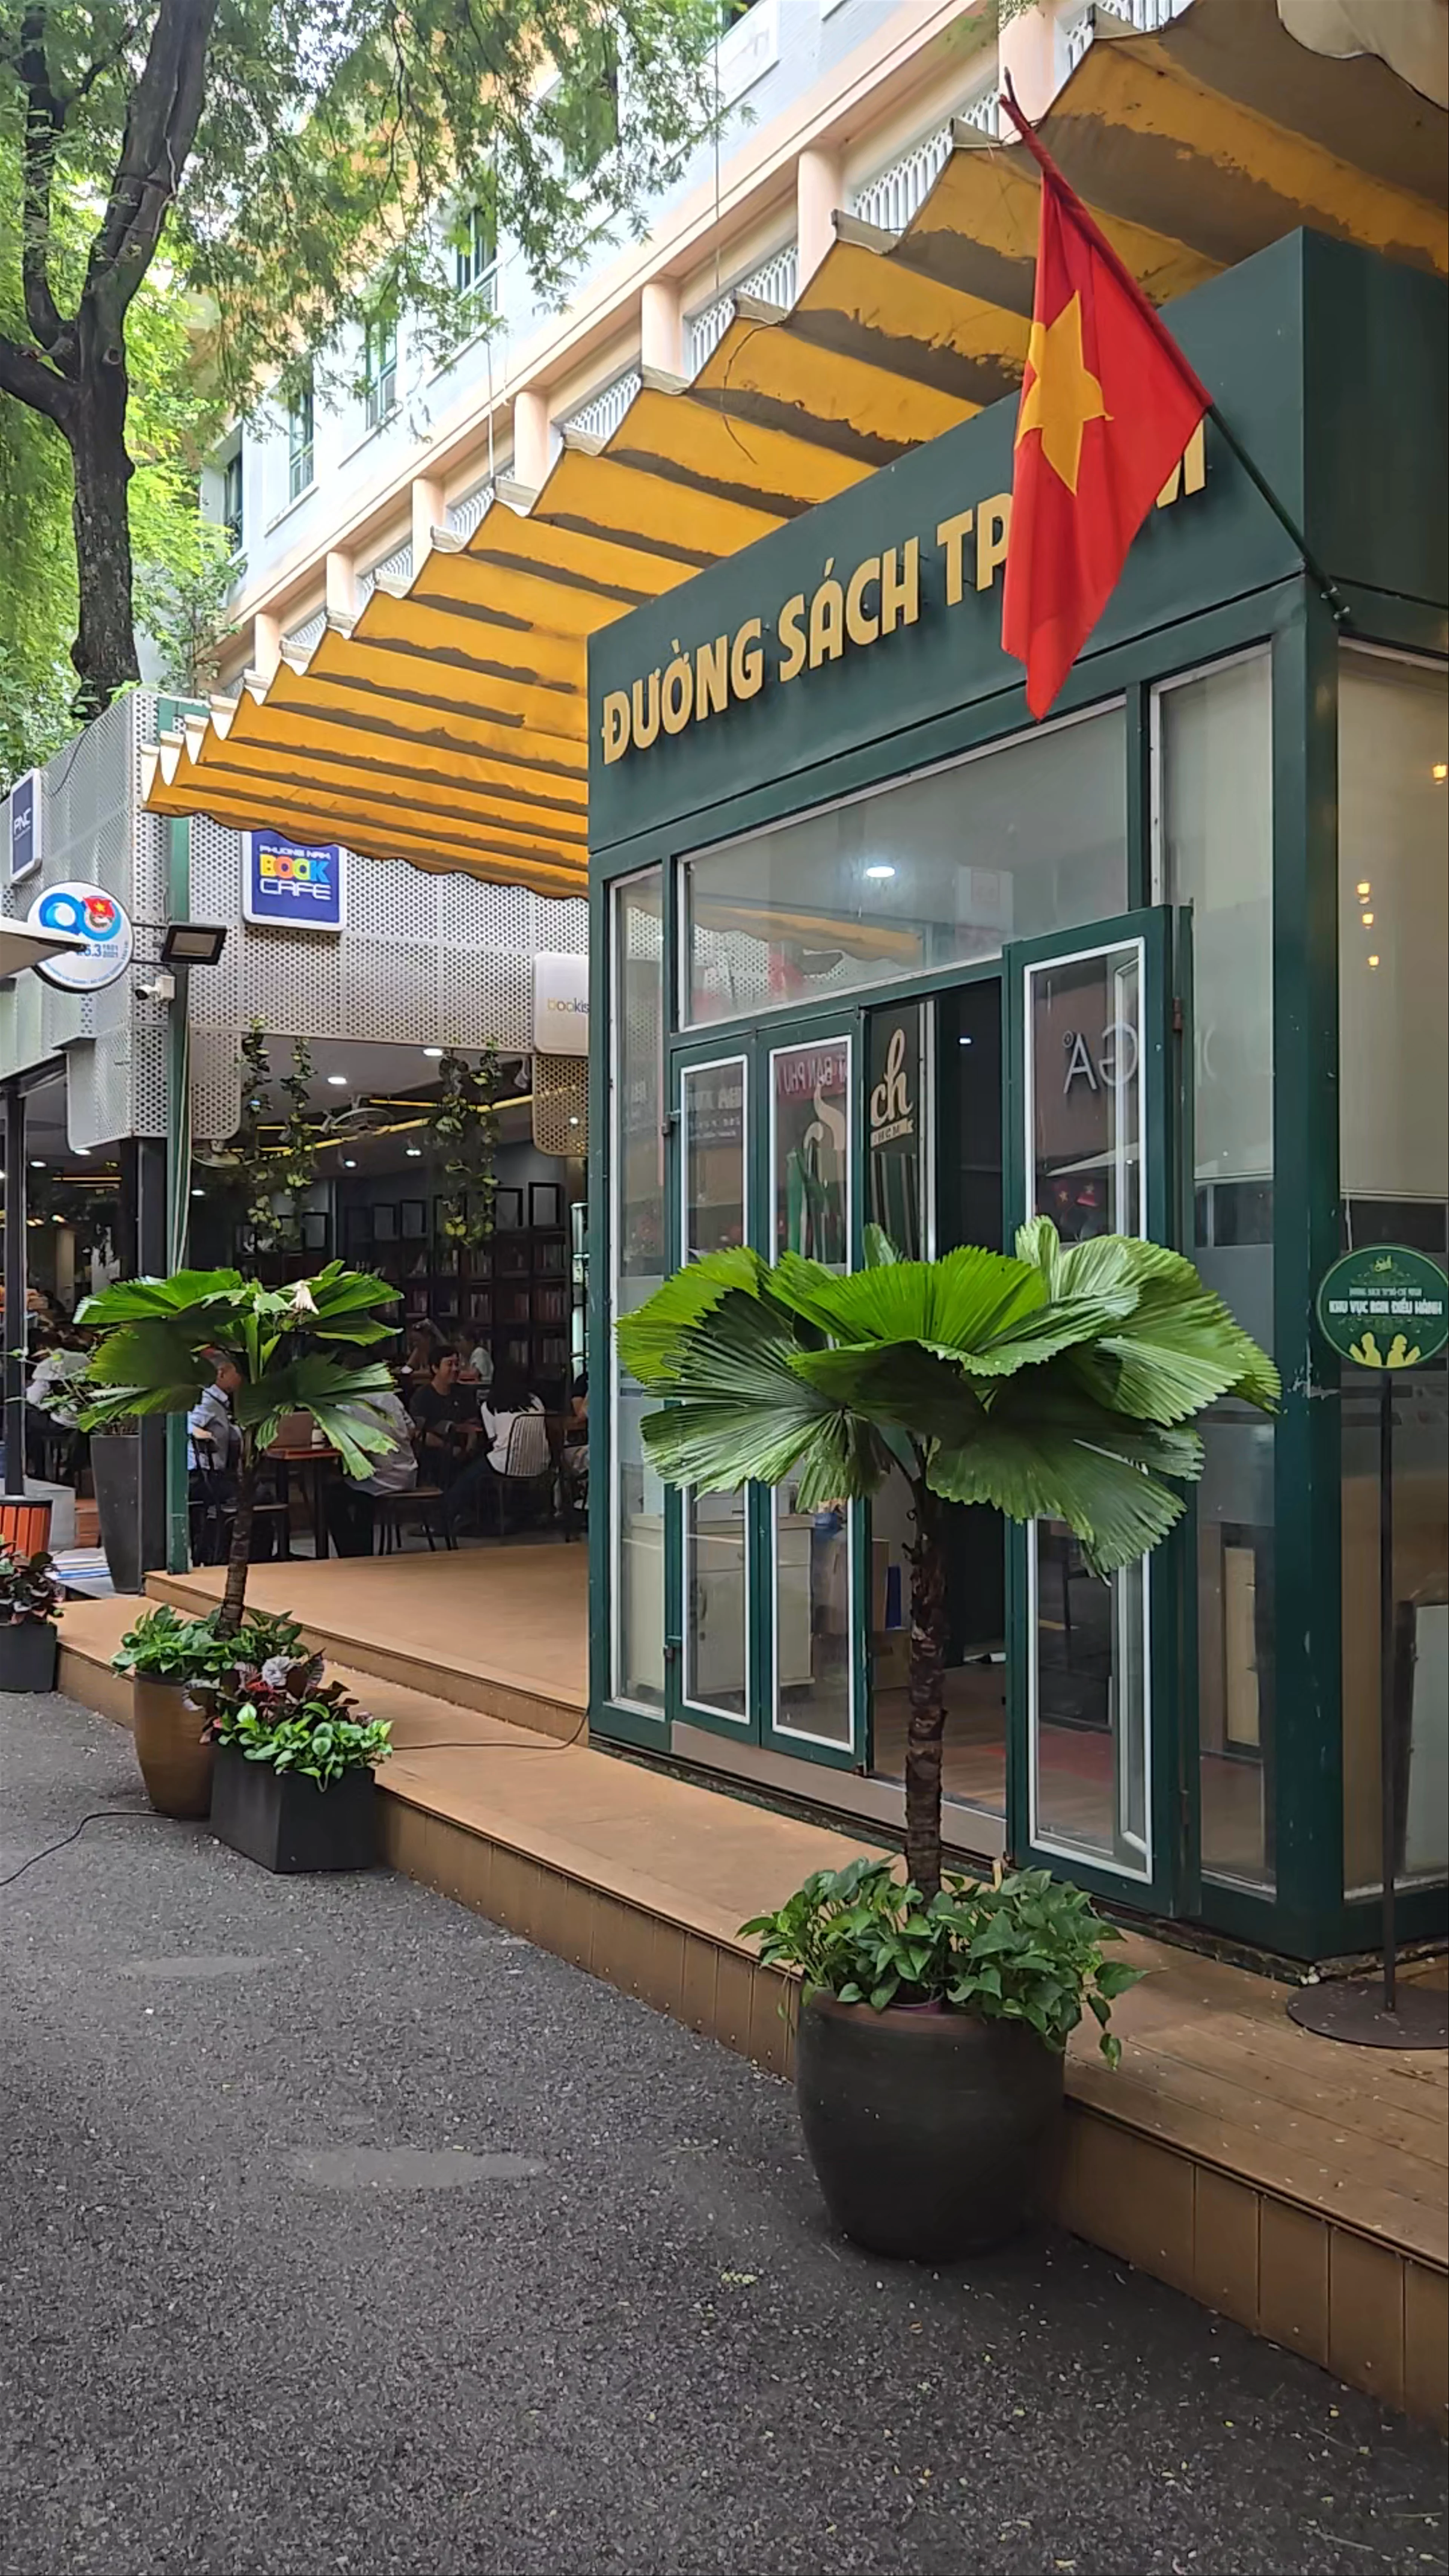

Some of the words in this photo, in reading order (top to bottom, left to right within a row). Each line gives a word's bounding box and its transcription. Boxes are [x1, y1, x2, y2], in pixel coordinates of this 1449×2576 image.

[601, 618, 763, 765] ĐƯỜNG
[778, 536, 920, 682] SÁCH
[260, 854, 330, 883] BOOK
[260, 878, 331, 900] CAFE
